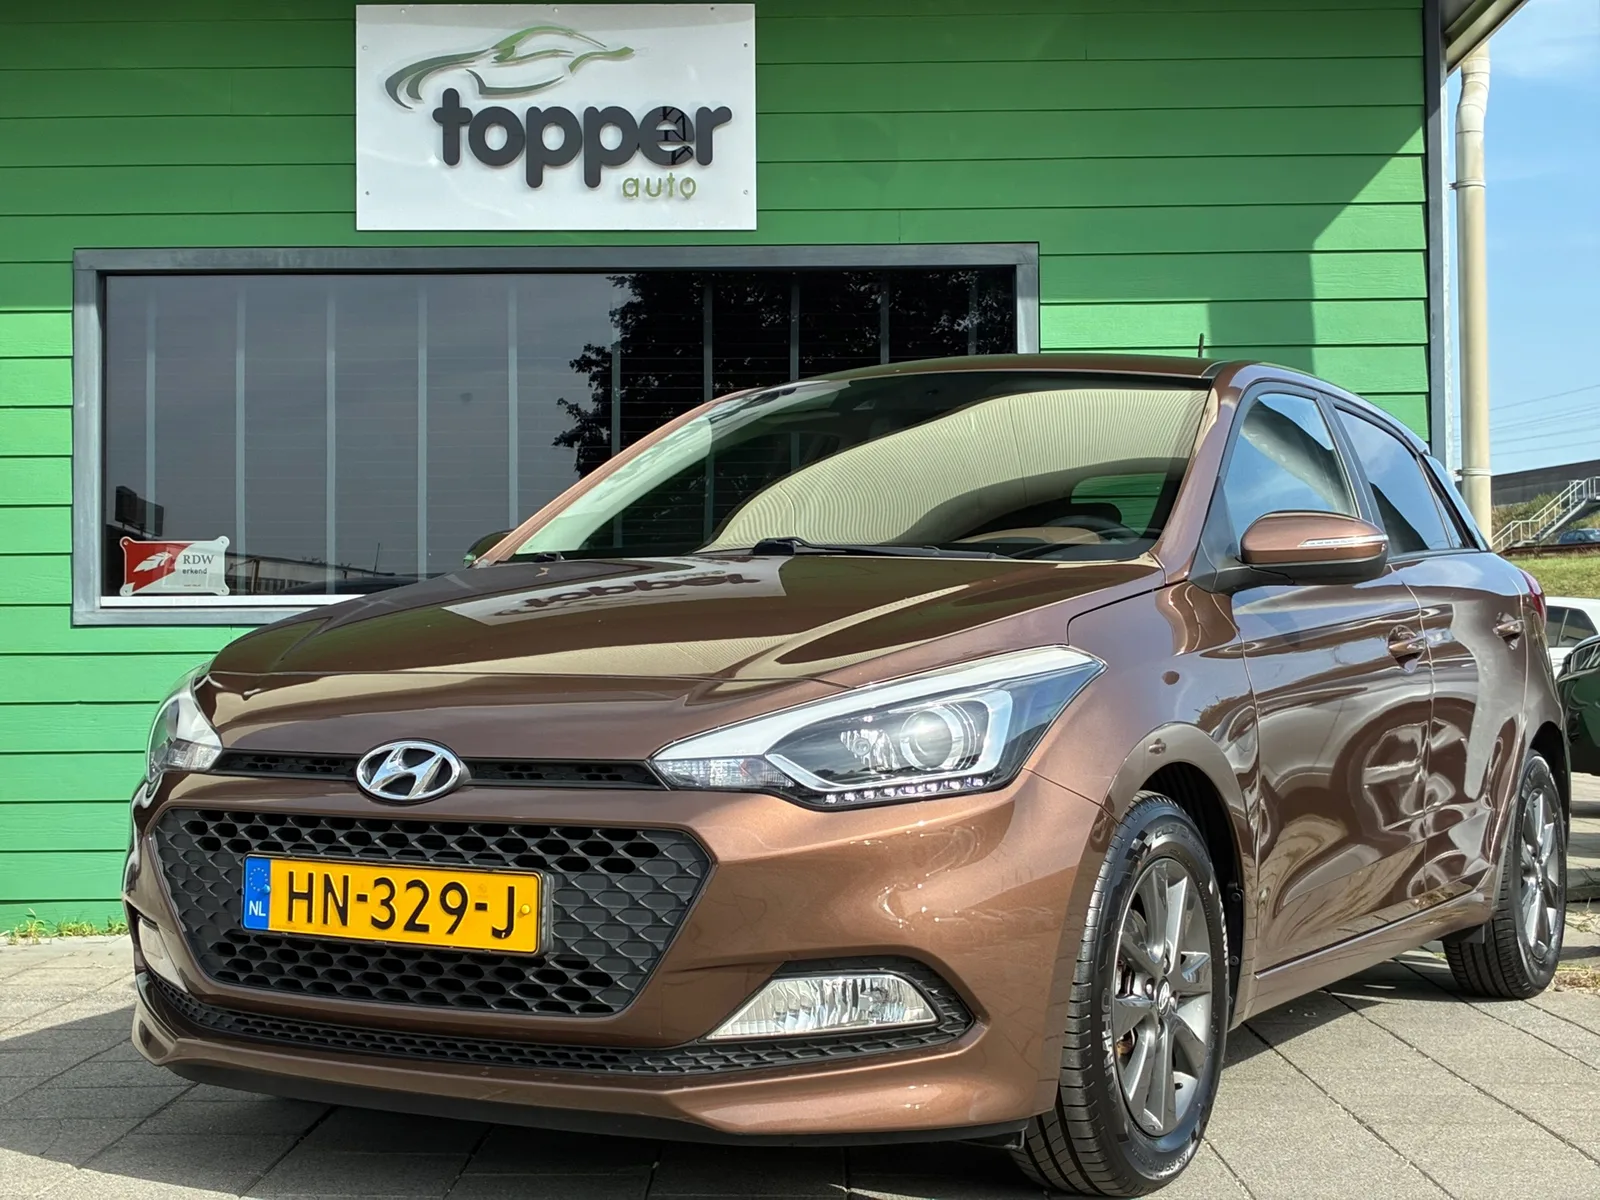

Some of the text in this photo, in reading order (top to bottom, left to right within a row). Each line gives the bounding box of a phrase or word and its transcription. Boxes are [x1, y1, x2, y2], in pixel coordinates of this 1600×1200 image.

[432, 87, 733, 189] topper
[621, 172, 697, 199] auto
[182, 554, 215, 565] RDW
[182, 567, 208, 575] erkend
[249, 900, 266, 917] NL
[287, 870, 516, 940] HN-329-J
